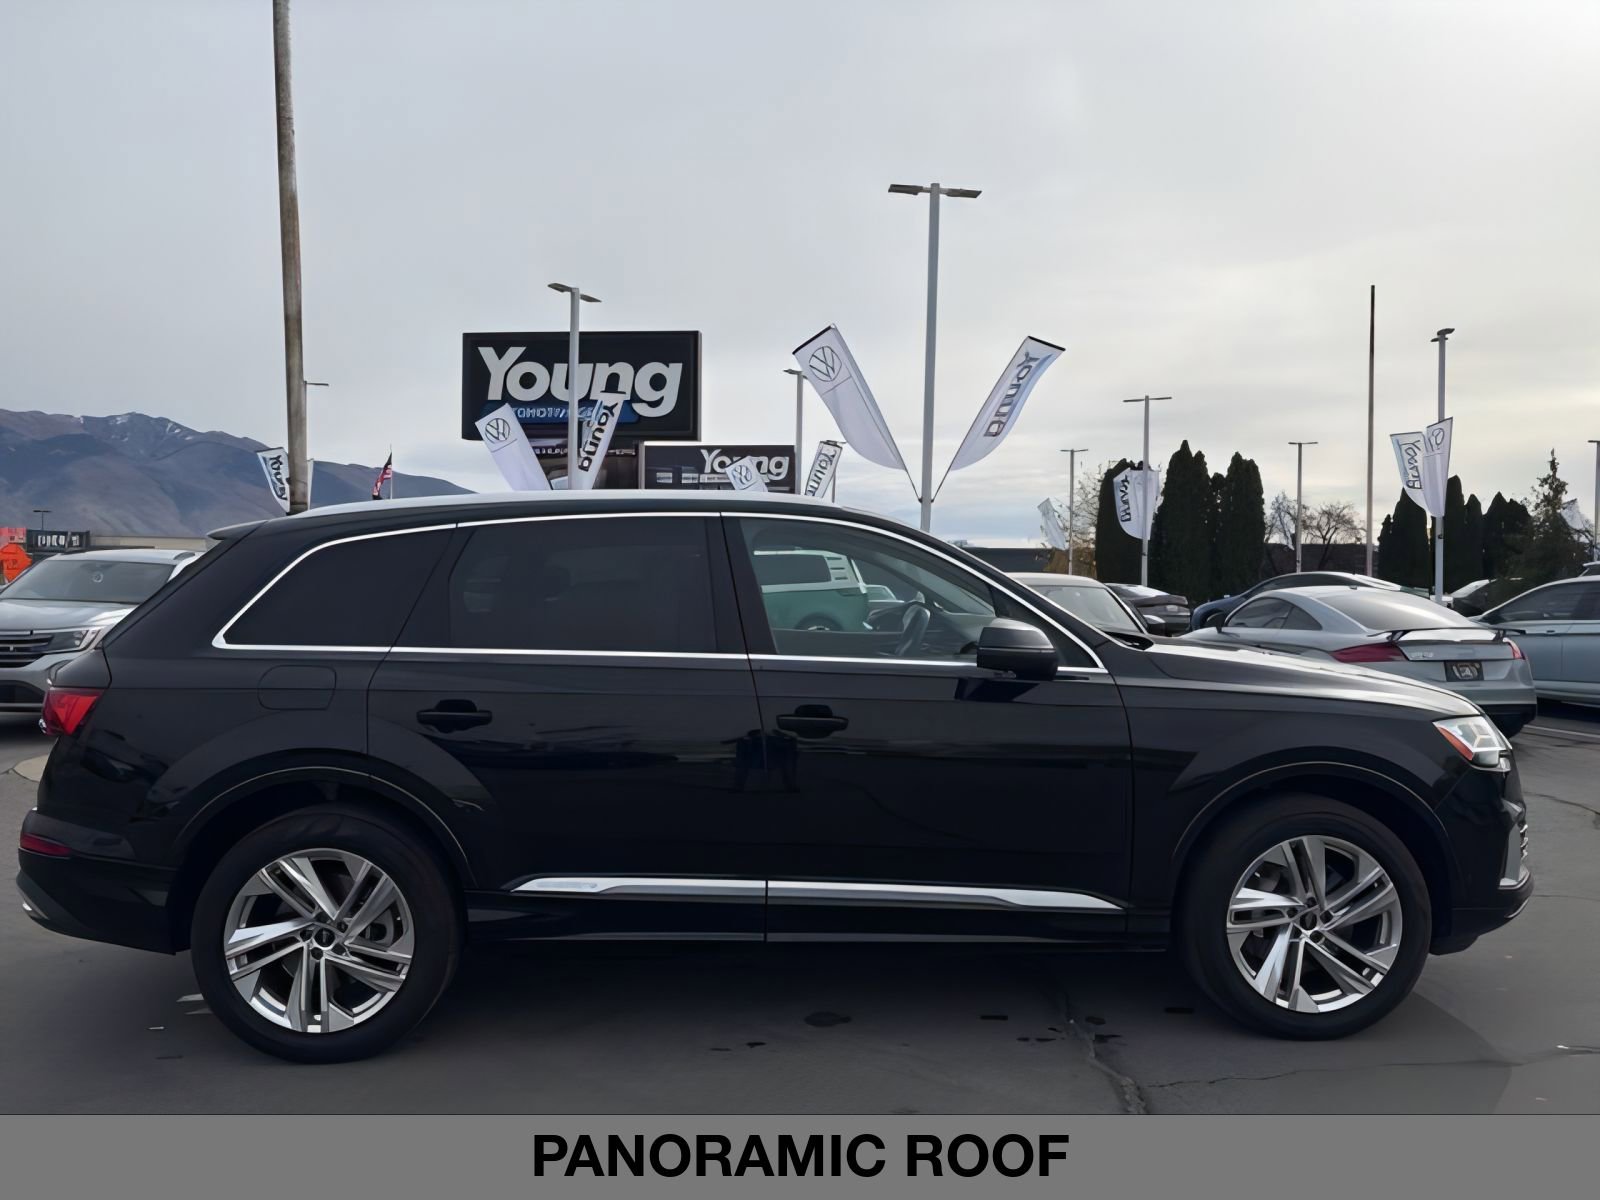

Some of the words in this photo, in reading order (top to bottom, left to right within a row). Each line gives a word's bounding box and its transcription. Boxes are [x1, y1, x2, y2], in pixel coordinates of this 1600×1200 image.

[478, 347, 683, 417] Young
[578, 402, 618, 472] Young
[701, 449, 790, 480] Yong
